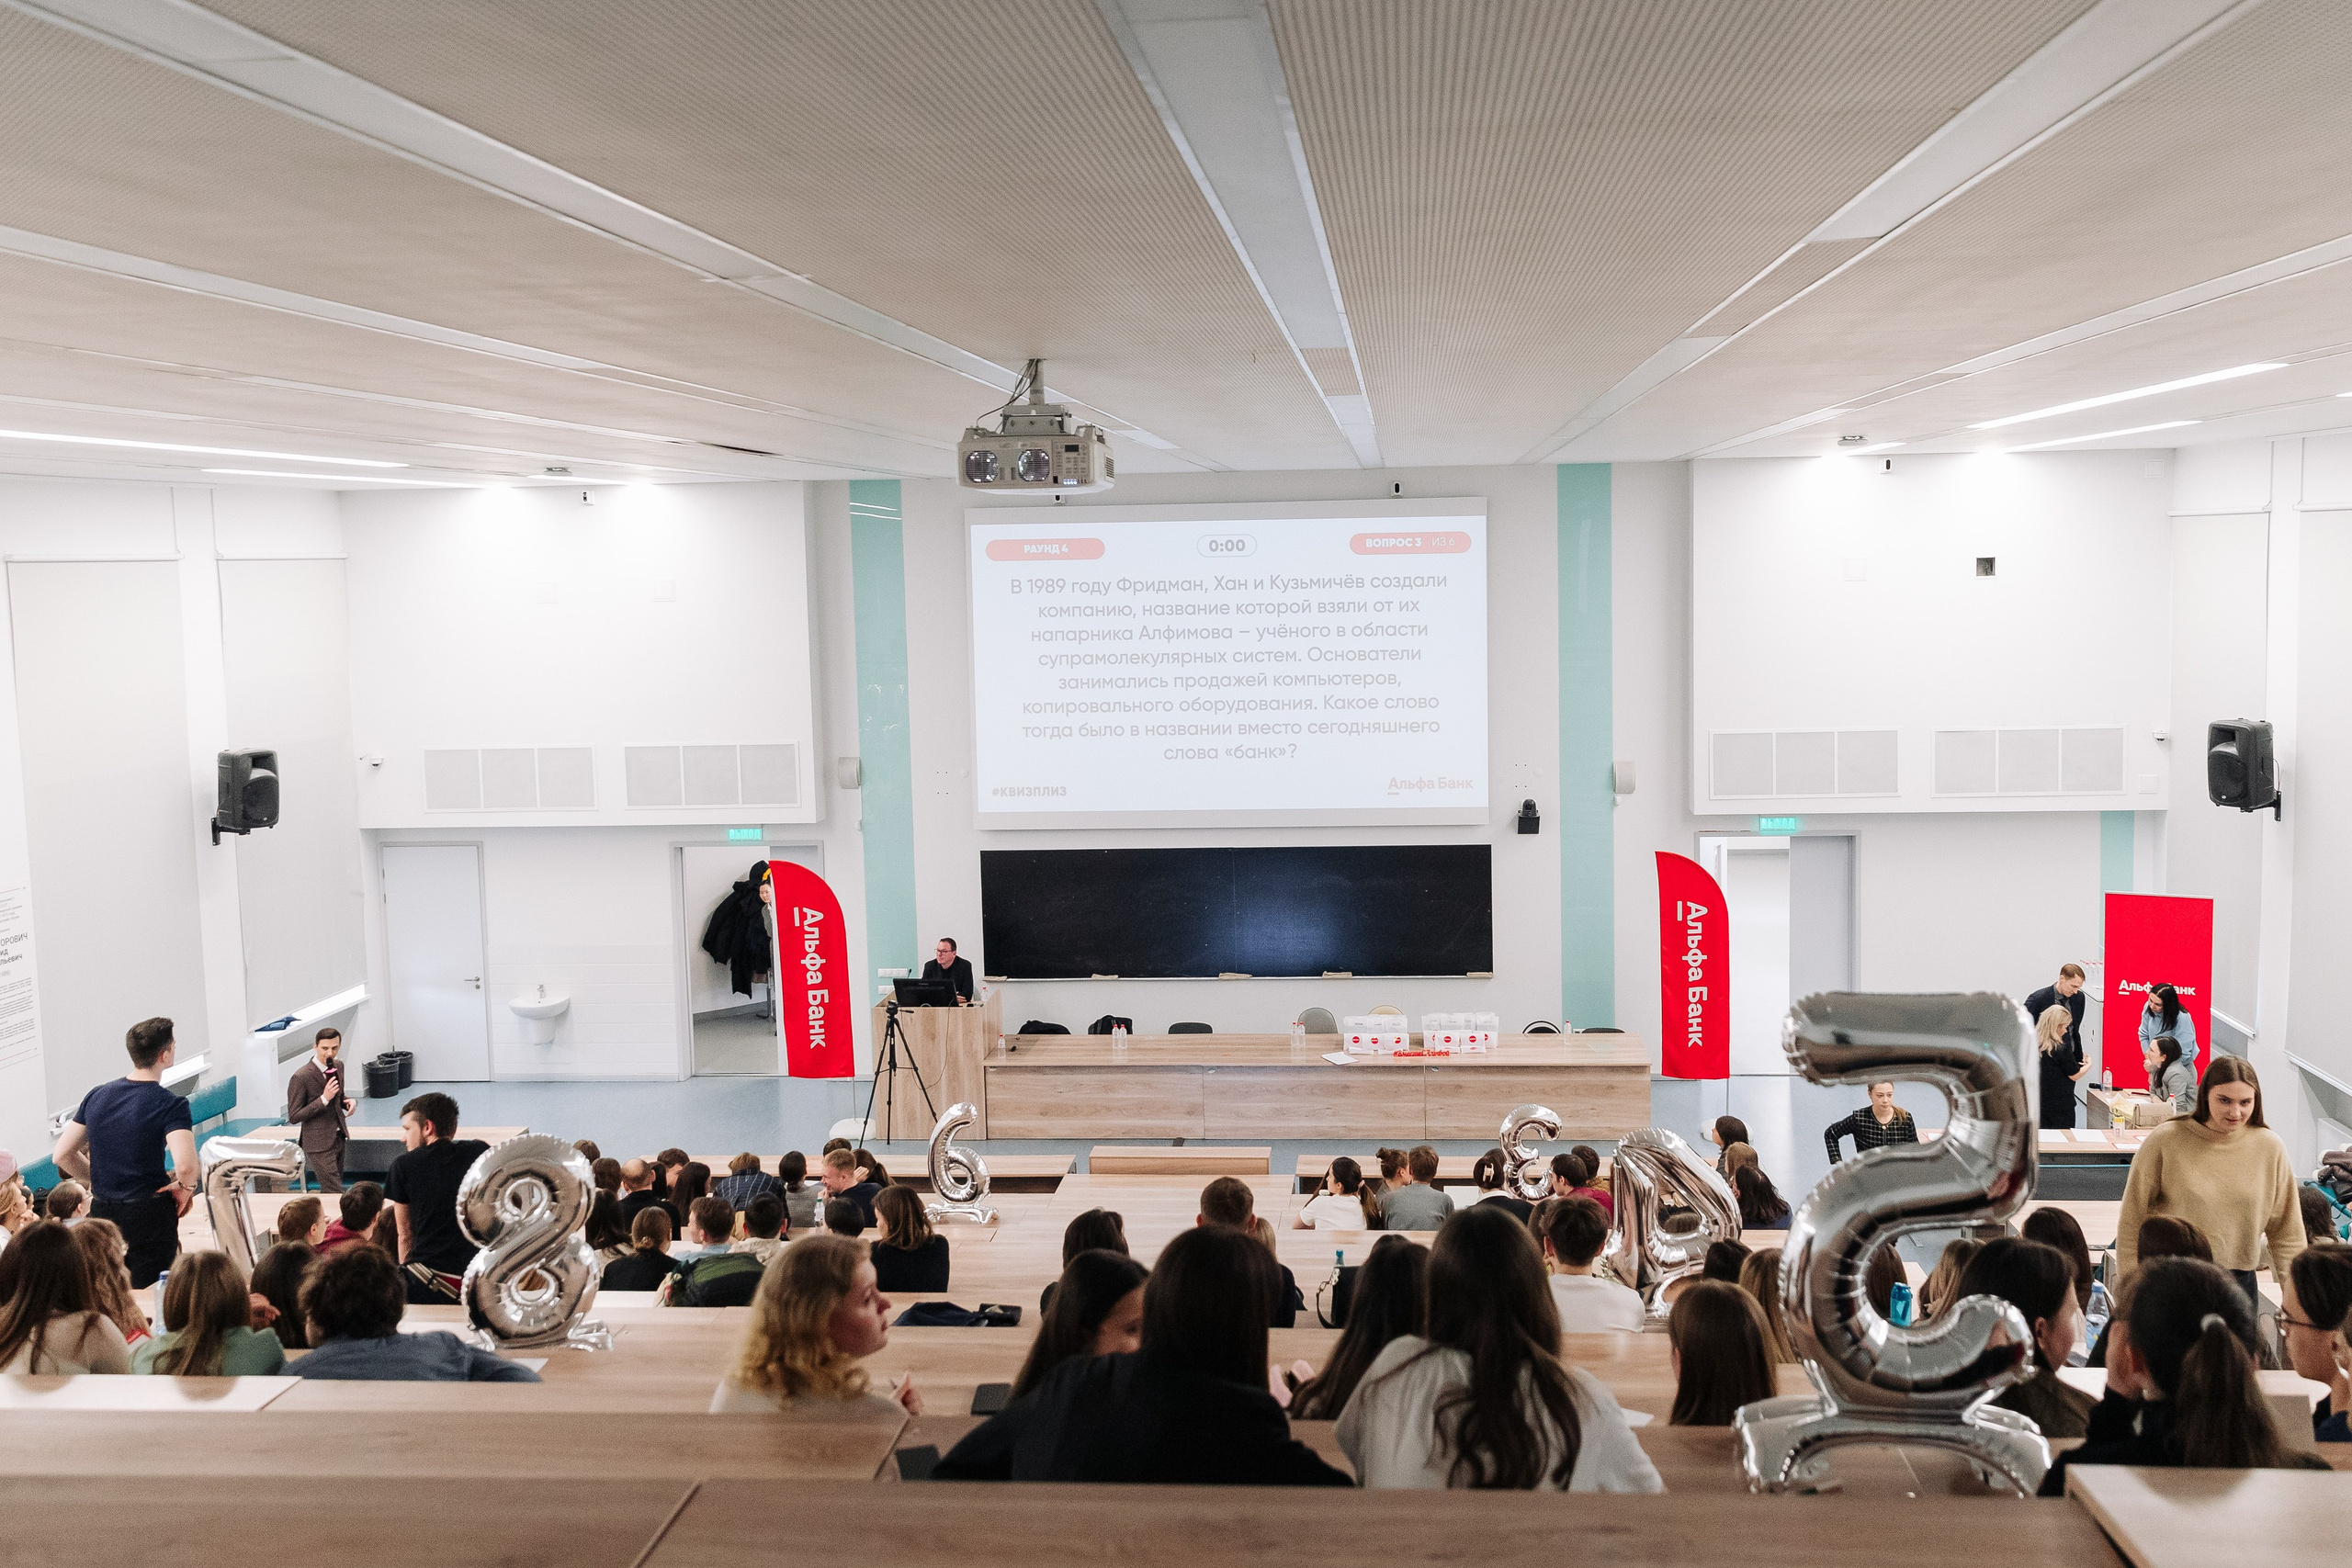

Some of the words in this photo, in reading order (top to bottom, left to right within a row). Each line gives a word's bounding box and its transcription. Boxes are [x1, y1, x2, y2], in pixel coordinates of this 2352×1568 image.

[1023, 544, 1060, 554] РАУНД
[1061, 544, 1069, 554] 4
[1208, 539, 1247, 553] 0:00
[1365, 537, 1413, 547] ВОПРОС
[1415, 537, 1422, 547] 3
[1431, 537, 1446, 547] ИЗ
[1449, 536, 1455, 547] 6
[1011, 579, 1023, 594] В
[1026, 577, 1067, 594] 1989
[1071, 581, 1113, 597] году
[1115, 576, 1209, 597] Фридман,
[1213, 575, 1249, 592] Хан
[1253, 578, 1264, 591] и
[1270, 573, 1365, 594] Кузьмичёв
[1369, 575, 1447, 591] создали
[1038, 604, 1137, 620] компанию,
[1142, 603, 1231, 616] название
[1235, 599, 1312, 618] которой
[1317, 601, 1368, 614] взяли
[1373, 600, 1395, 614] от
[1398, 600, 1420, 613] их
[1031, 628, 1134, 646] напарника
[1137, 624, 1233, 644] Алфимова
[1255, 623, 1331, 643] учёного
[1336, 626, 1347, 637] в
[1351, 621, 1429, 637] области
[1038, 651, 1227, 670] супрамолекулярных
[1232, 650, 1302, 663] систем.
[1306, 646, 1421, 662] Основатели
[1057, 676, 1169, 690] занимались
[1173, 671, 1268, 692] продажей
[1272, 672, 1402, 690] компьютеров,
[1023, 700, 1174, 717] копировального
[1179, 695, 1318, 716] оборудования.
[1323, 694, 1379, 710] Какое
[1384, 696, 1440, 709] слово
[1022, 726, 1073, 740] тогда
[1078, 721, 1125, 738] было
[1130, 724, 1140, 737] в
[1145, 723, 1233, 737] названии
[1238, 722, 1303, 736] вместо
[1306, 721, 1441, 737] сегодняшнего
[1163, 747, 1219, 761] слова
[1224, 742, 1298, 760] «банк»?
[991, 785, 1068, 797] #КВИЗПЛИЗ
[1387, 776, 1435, 793] Альфа
[1438, 776, 1474, 789] Банк
[0, 931, 28, 947] ОРОВИЧ
[800, 906, 826, 986] Альфа
[1681, 900, 1708, 982] Альфа
[2118, 979, 2154, 995] Альф
[808, 988, 829, 1050] Банк
[1688, 986, 1708, 1048] Банк
